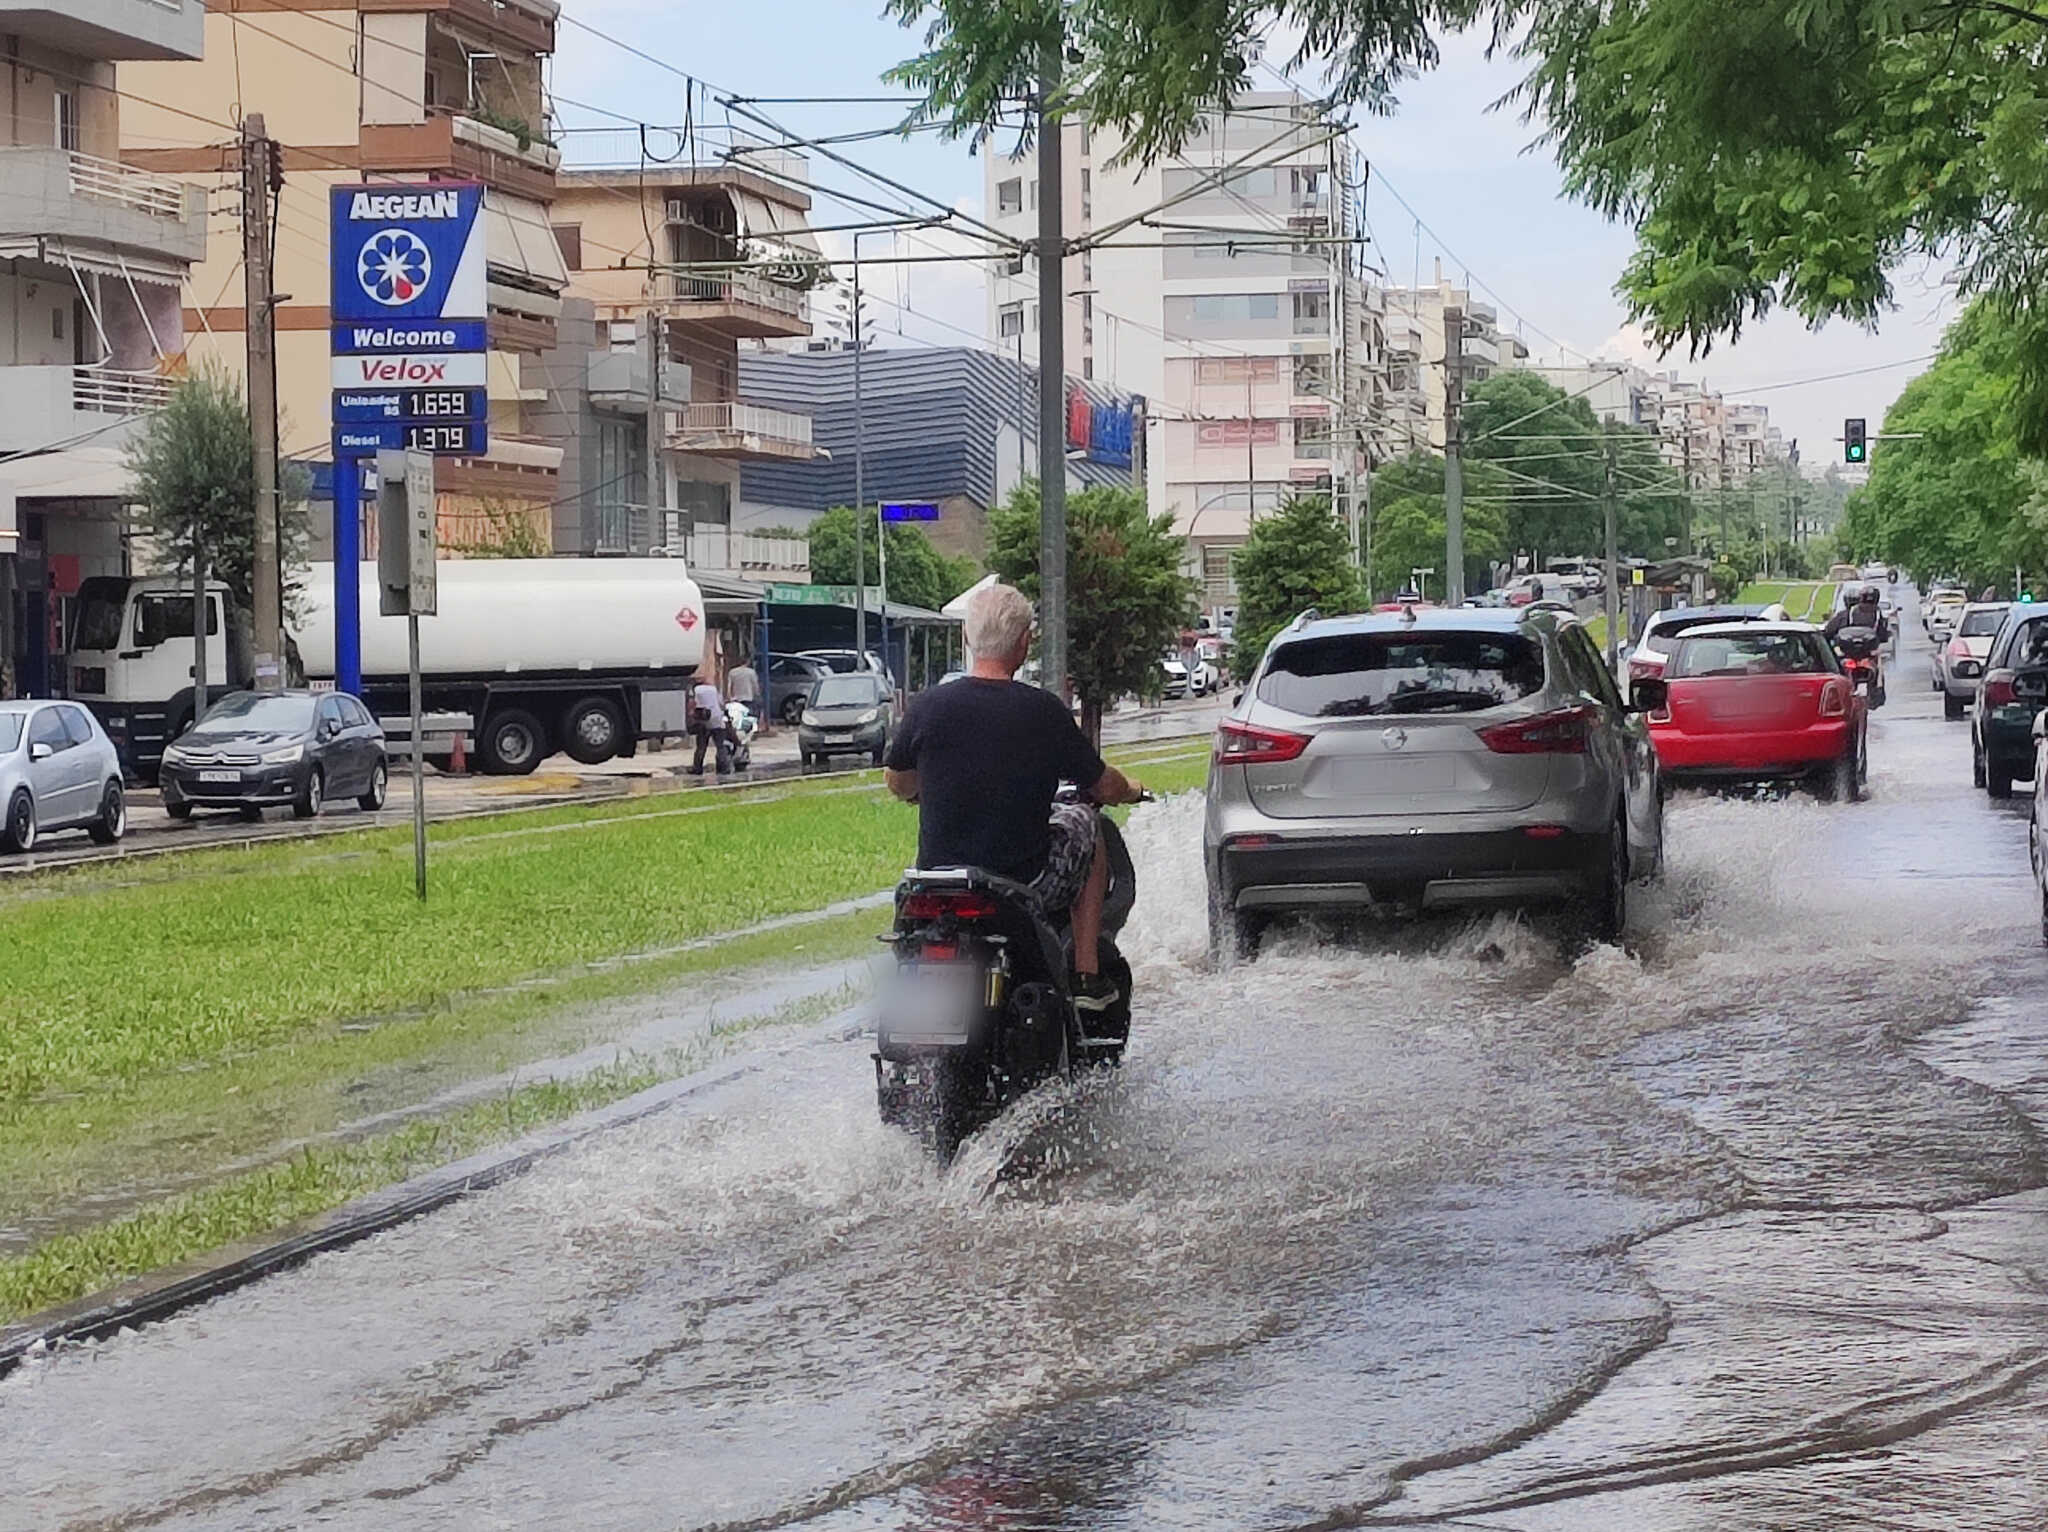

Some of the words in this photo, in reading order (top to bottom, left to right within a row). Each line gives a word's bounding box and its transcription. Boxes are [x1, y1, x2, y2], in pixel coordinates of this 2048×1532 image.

[350, 191, 458, 219] AEGEAN
[353, 328, 456, 348] Welcome
[361, 358, 447, 383] Velox
[411, 393, 465, 415] 1.659
[341, 435, 380, 446] Diesel
